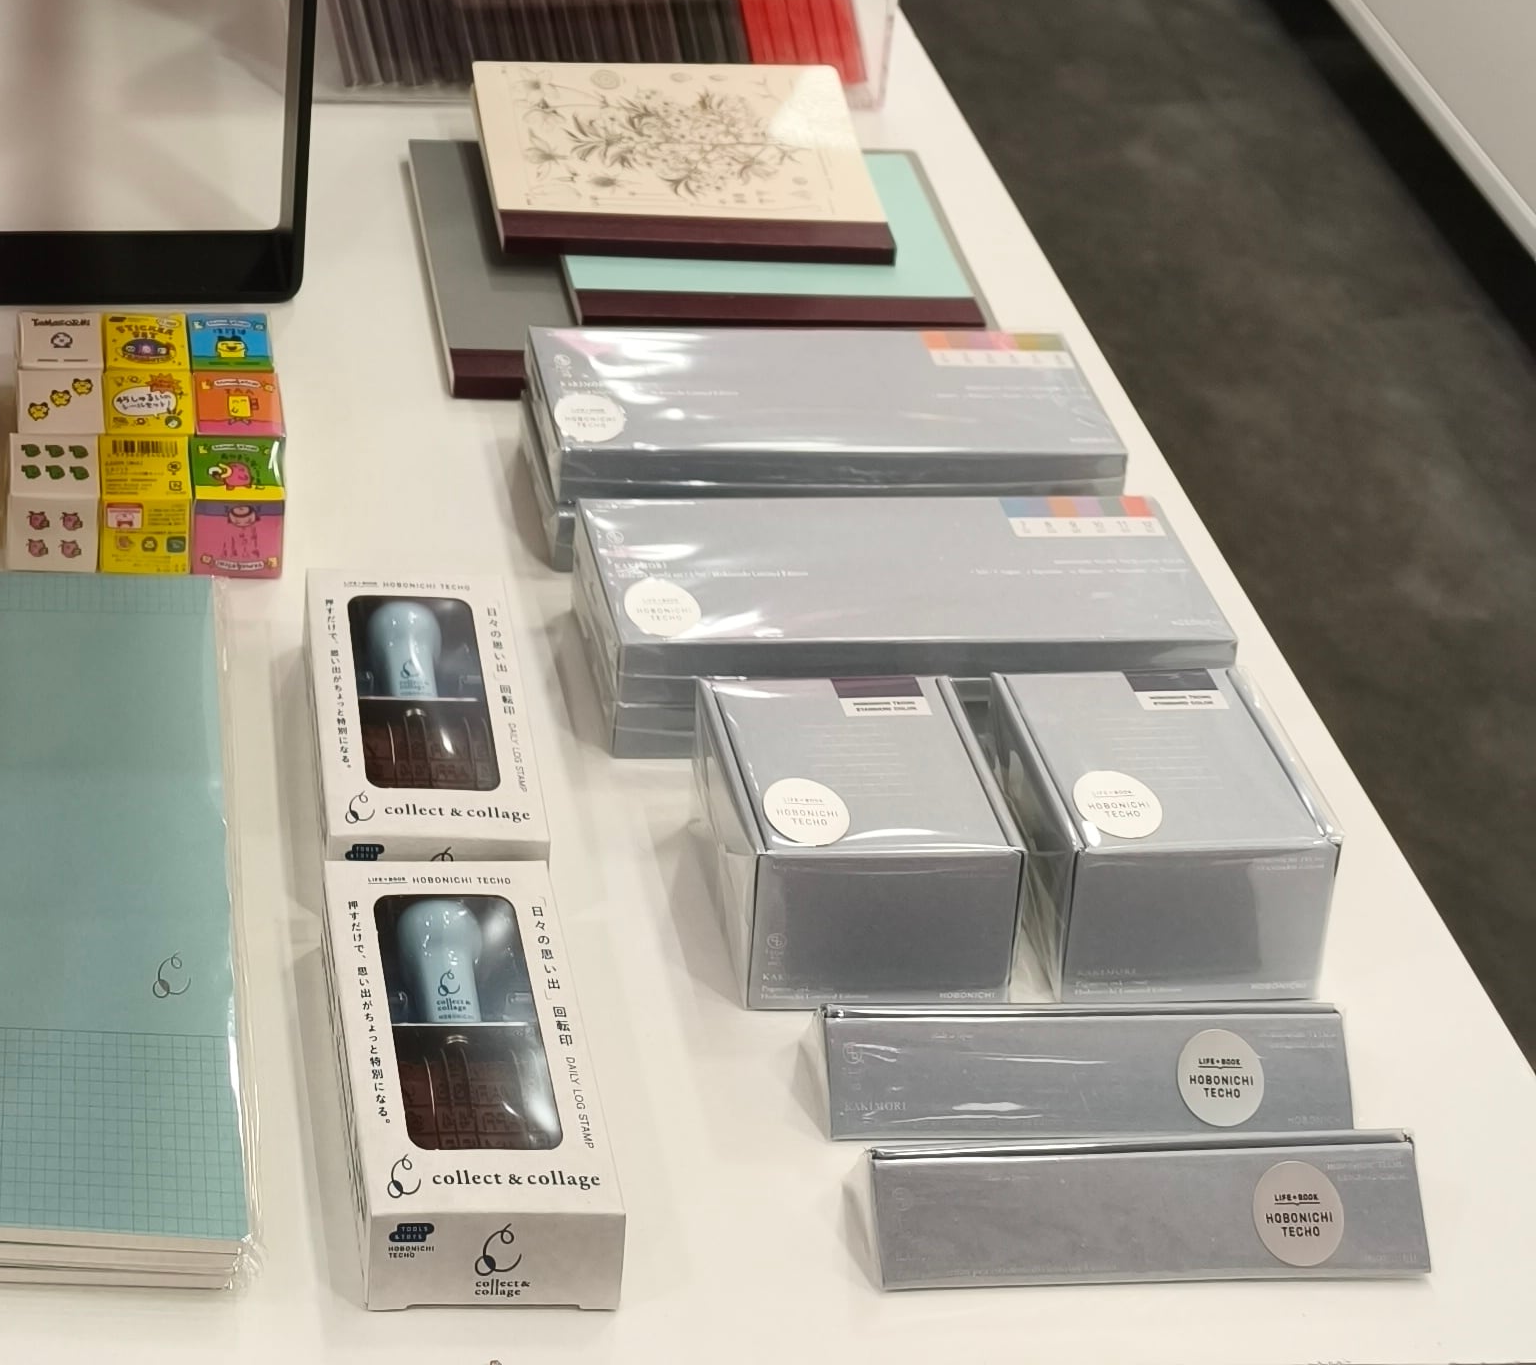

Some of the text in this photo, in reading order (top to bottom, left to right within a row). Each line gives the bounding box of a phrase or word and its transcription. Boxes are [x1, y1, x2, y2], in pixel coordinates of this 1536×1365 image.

[1088, 801, 1150, 810] HOBONICHI
[384, 804, 531, 822] collect & collage
[775, 808, 839, 818] HOBONICHI
[1105, 810, 1141, 818] TECHO
[412, 876, 512, 885] HOBONICHI TECHO
[1189, 1075, 1254, 1086] HOBONICHI
[1203, 1087, 1241, 1098] TECHO
[565, 1056, 594, 1149] DAILY LOG STAMP
[432, 1170, 601, 1190] collect & collage
[1266, 1212, 1333, 1224] HOBONICHI
[1281, 1226, 1320, 1237] TECHO
[475, 1287, 521, 1297] collage
